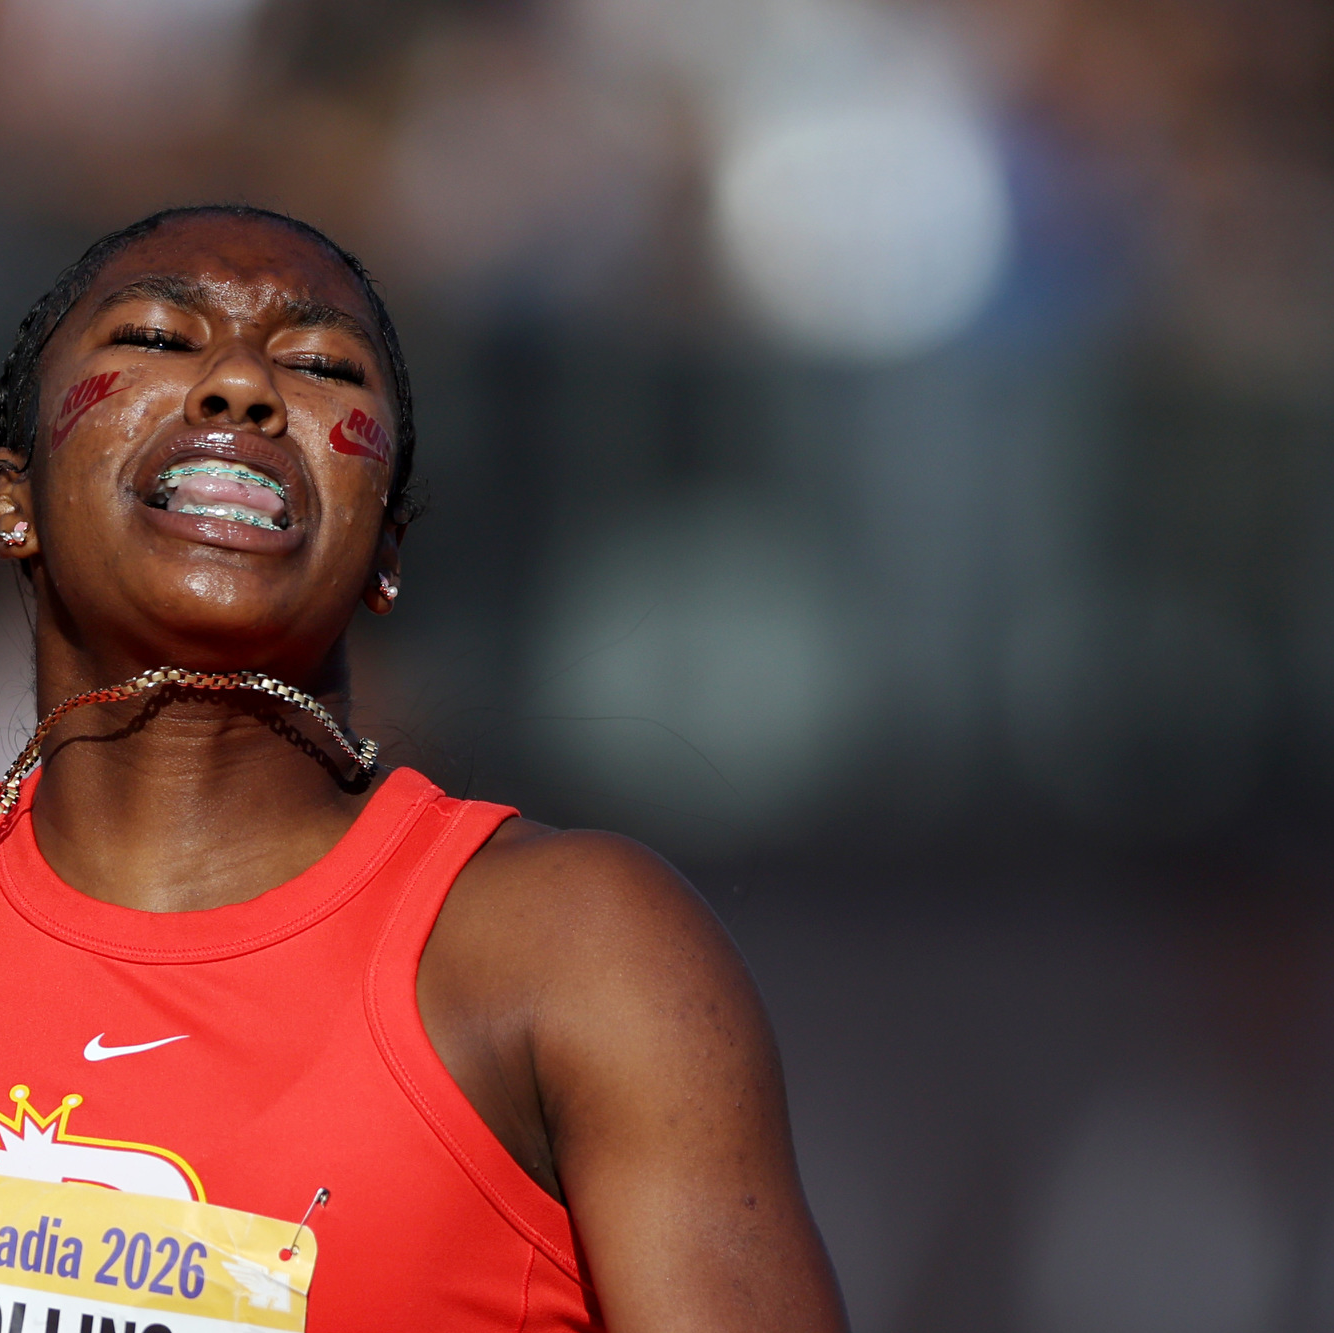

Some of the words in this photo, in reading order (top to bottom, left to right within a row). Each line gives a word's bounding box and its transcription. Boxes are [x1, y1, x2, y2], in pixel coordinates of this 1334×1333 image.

[60, 371, 121, 419] RUN
[347, 408, 389, 459] RUN
[95, 1228, 207, 1299] 2026
